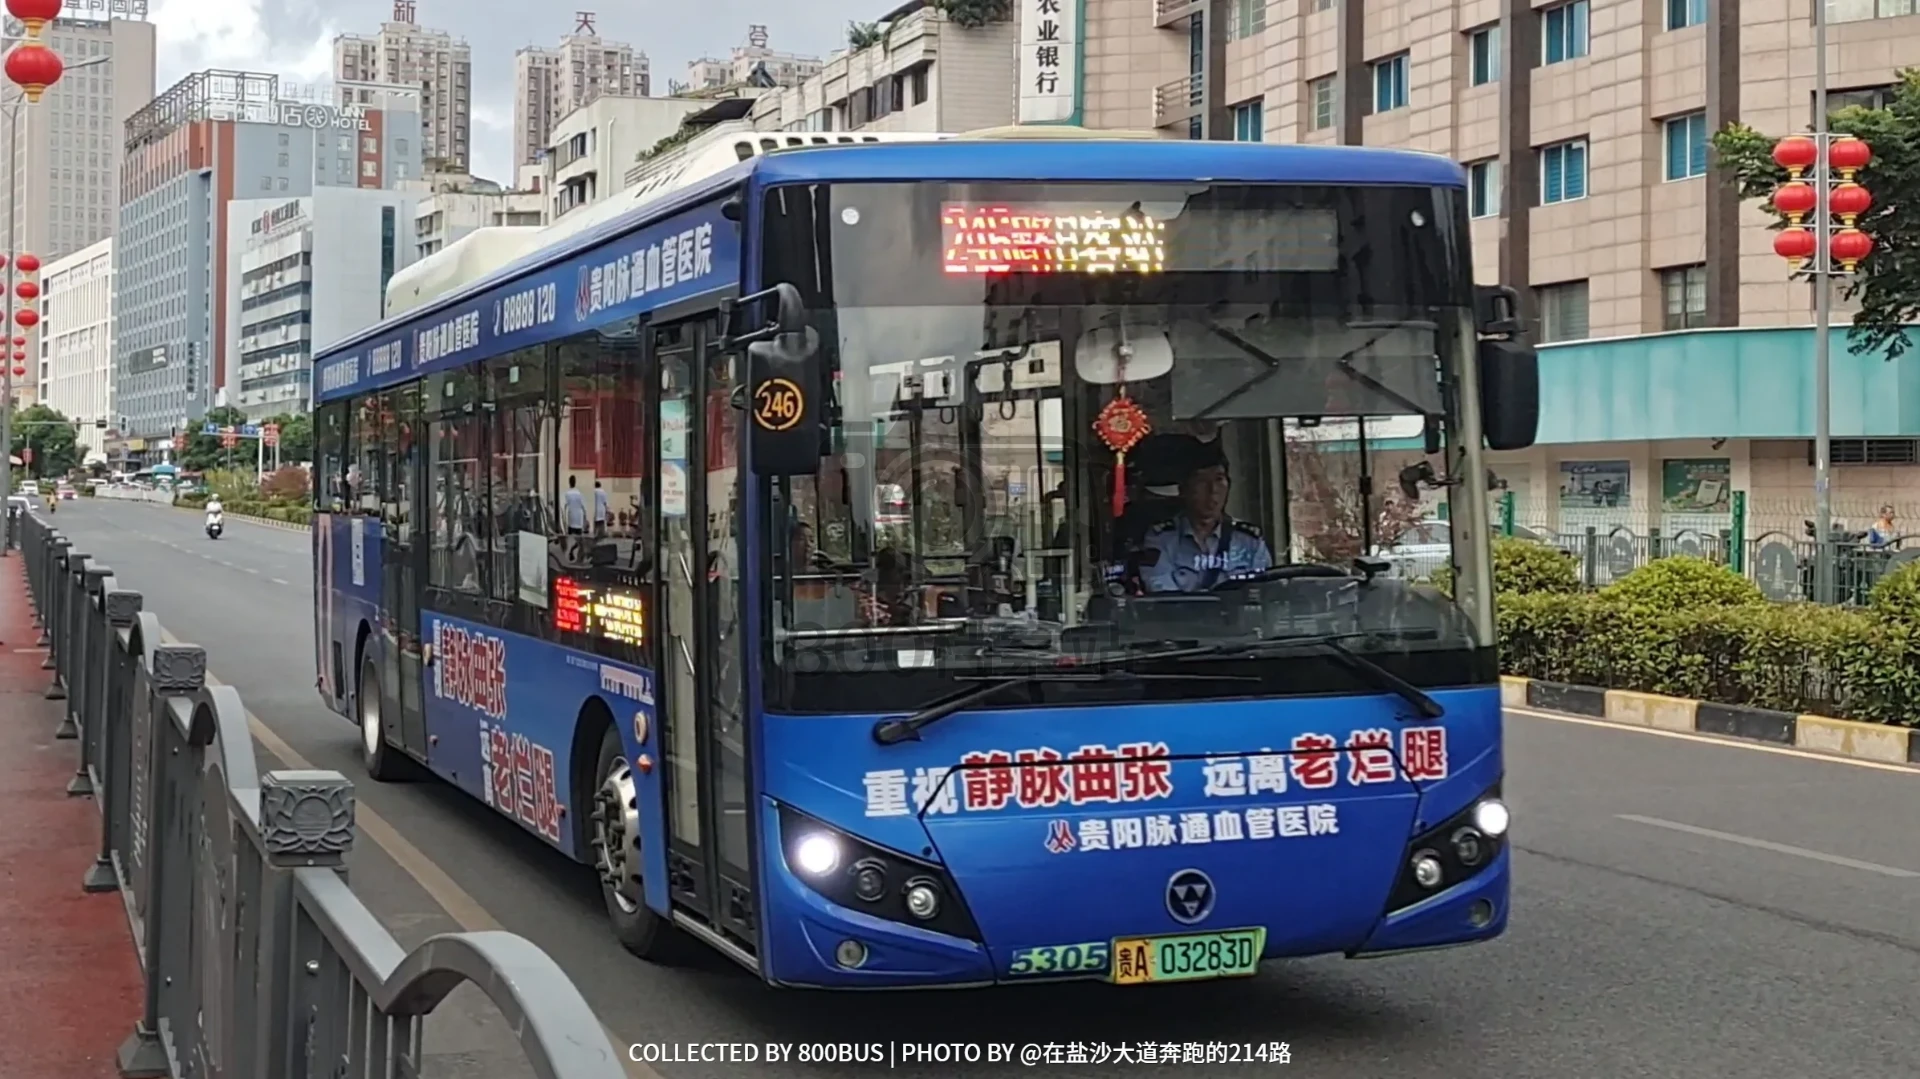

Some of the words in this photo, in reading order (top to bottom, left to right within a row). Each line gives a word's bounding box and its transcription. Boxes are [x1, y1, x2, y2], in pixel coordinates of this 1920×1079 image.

[575, 12, 596, 36] 天
[330, 117, 373, 131] HOTEL
[589, 222, 713, 314] 贵阳脉通血管医院
[503, 289, 535, 334] 88888
[537, 282, 556, 324] 120
[761, 391, 795, 418] 246
[1078, 804, 1340, 852] 贵阳脉通血管医院
[1010, 945, 1109, 975] 5305
[1161, 936, 1252, 975] 03283D
